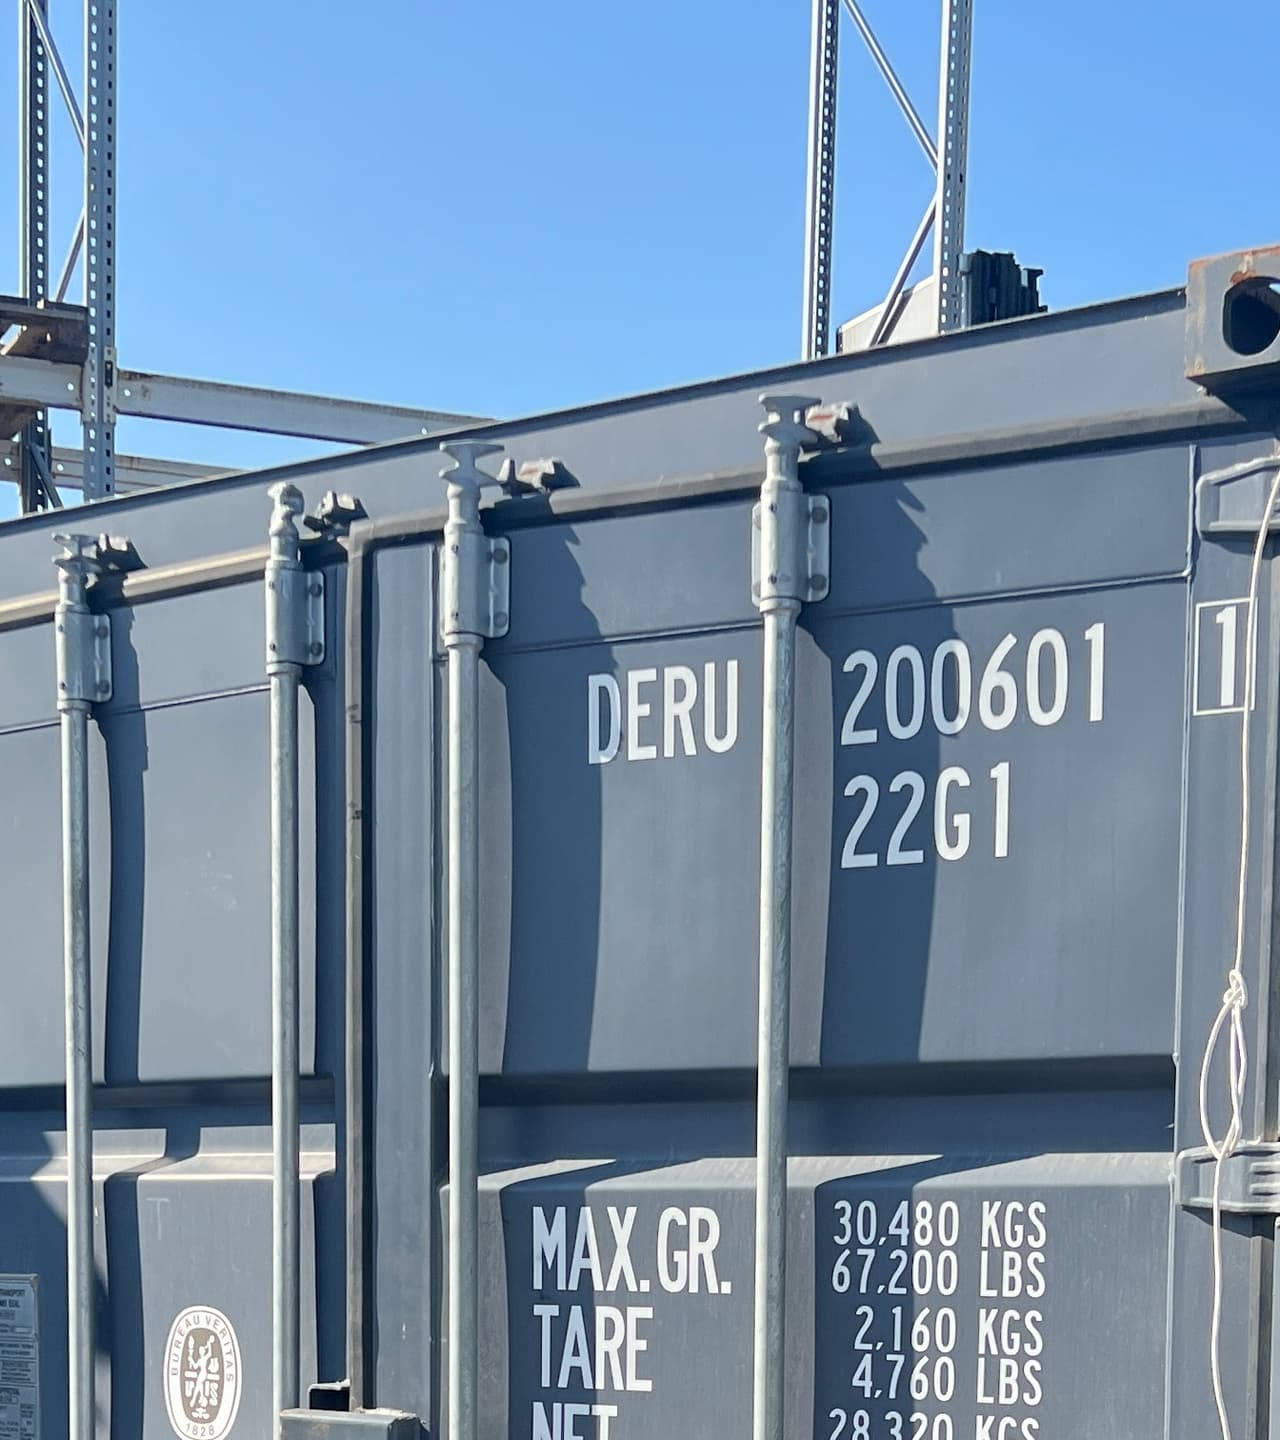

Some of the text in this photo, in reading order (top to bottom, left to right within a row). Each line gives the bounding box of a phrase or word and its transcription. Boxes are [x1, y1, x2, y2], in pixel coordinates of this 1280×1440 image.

[588, 605, 1238, 765] DERU 200601 1
[841, 761, 1010, 869] 22G1
[532, 1206, 732, 1294] MAX.GR.
[833, 1200, 1047, 1249] 30,480 KGS
[832, 1248, 1046, 1298] 67,200 LBS
[171, 1314, 234, 1382] BUREAU VERITAS
[533, 1304, 654, 1392] TARE
[854, 1305, 1044, 1357] 2,160 KGS
[851, 1353, 1042, 1406] 4,760 LBS
[185, 1422, 216, 1438] 1828
